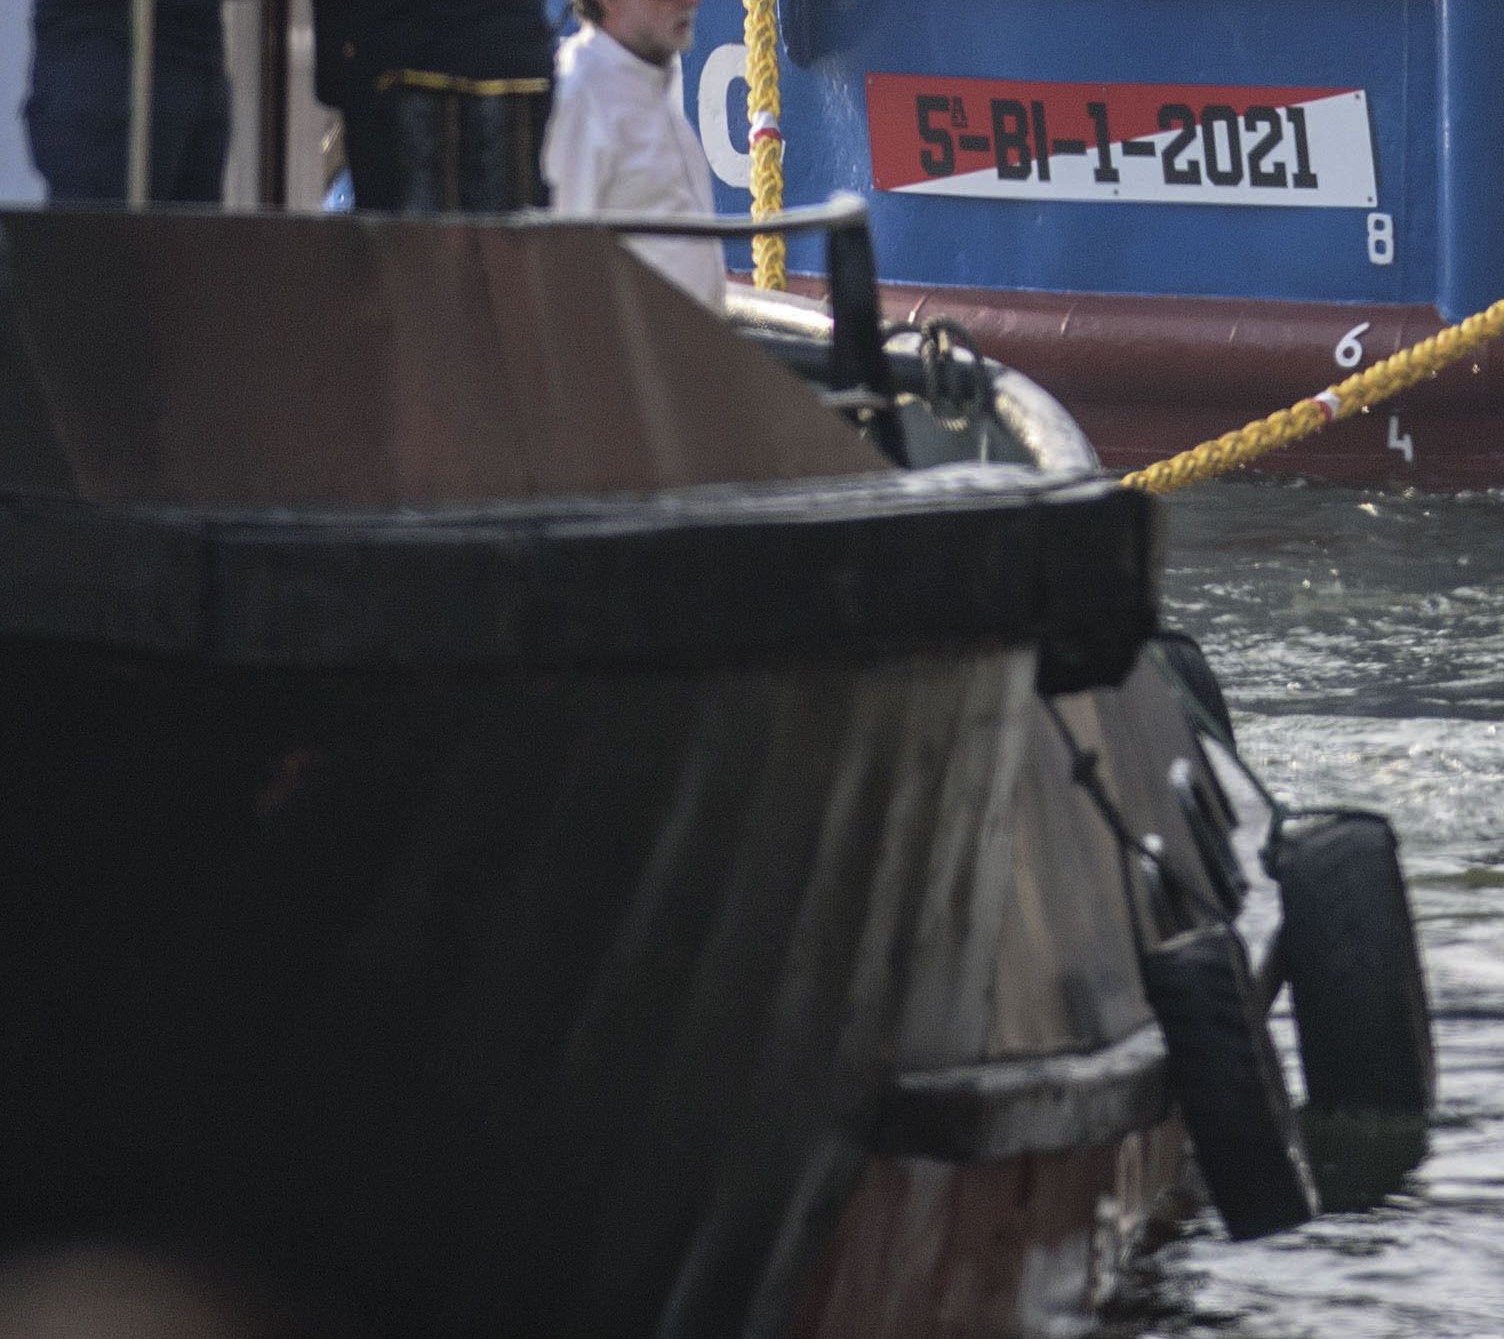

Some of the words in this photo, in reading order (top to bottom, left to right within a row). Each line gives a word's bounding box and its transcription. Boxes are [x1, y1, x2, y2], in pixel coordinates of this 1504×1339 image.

[1366, 212, 1395, 265] 8
[1335, 321, 1371, 368] 6
[1387, 414, 1414, 463] 4
